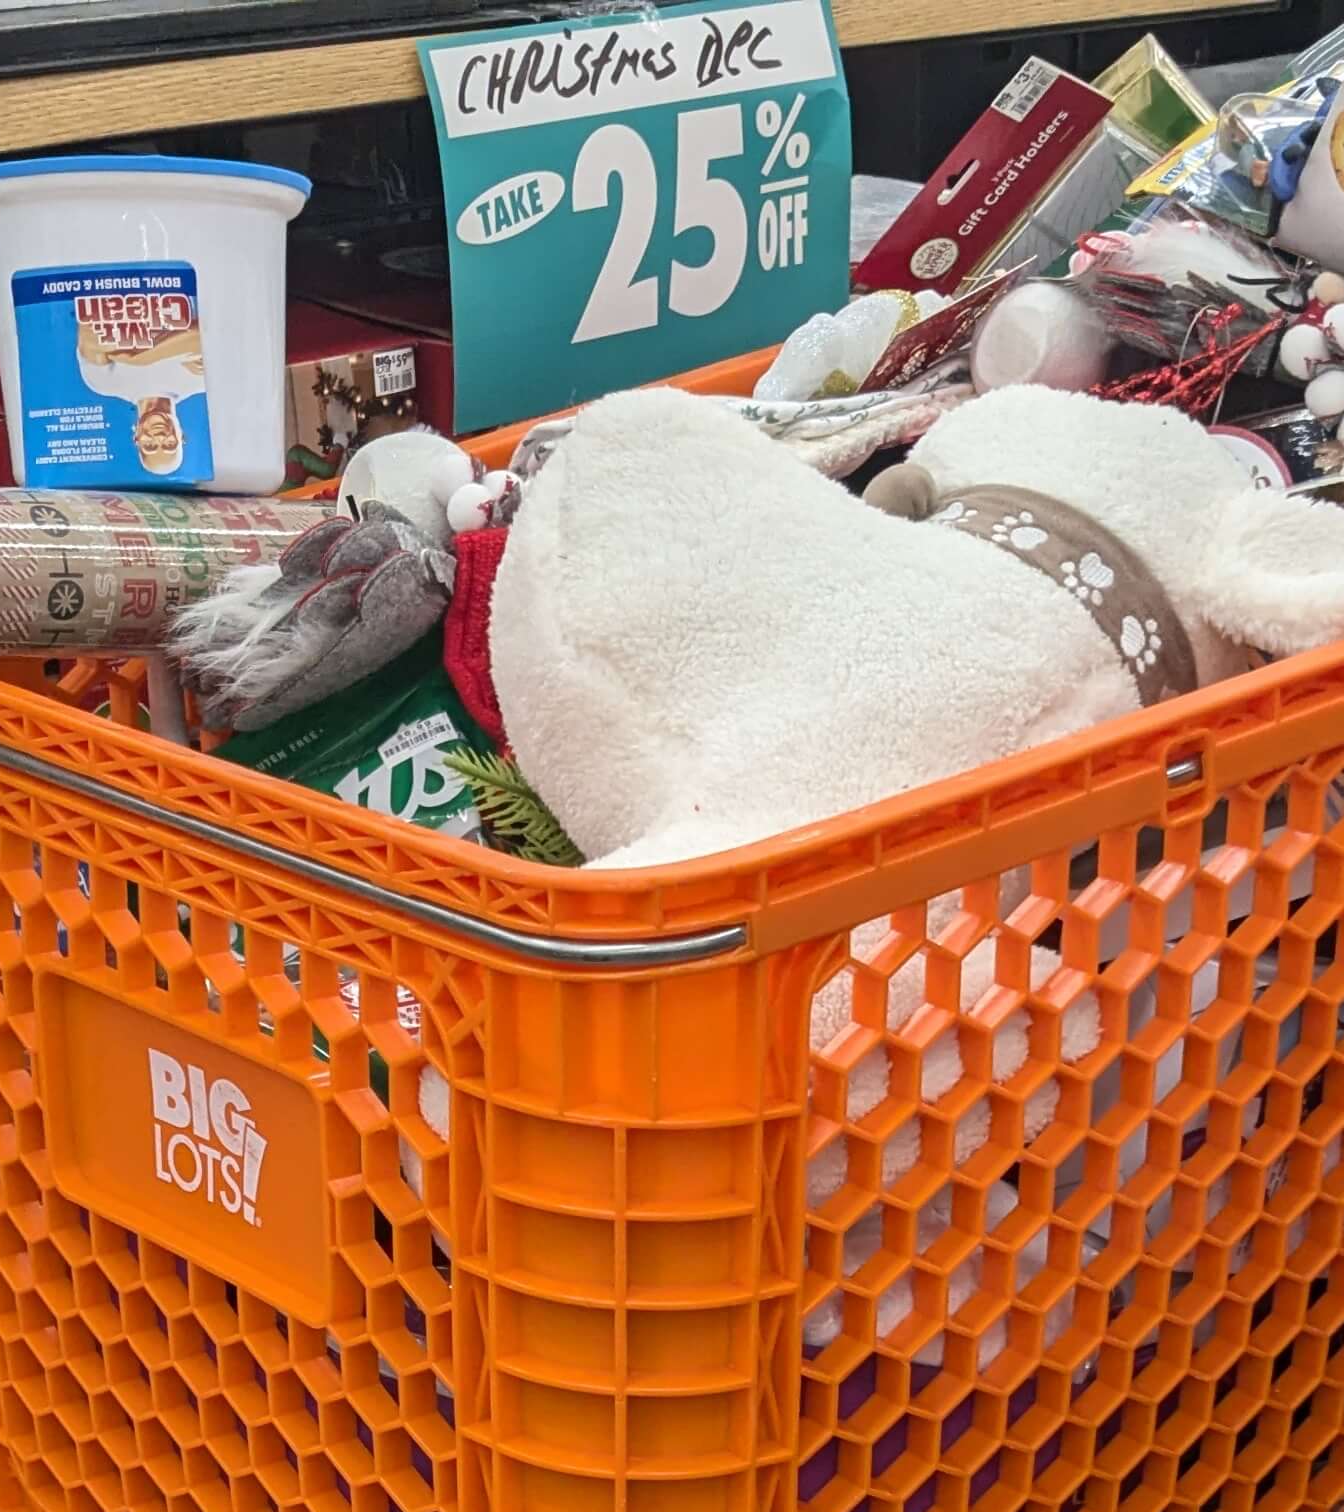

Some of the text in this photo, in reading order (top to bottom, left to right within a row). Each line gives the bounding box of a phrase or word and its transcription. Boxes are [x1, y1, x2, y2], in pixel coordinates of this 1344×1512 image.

[958, 110, 1069, 236] Gift Card Holders
[476, 179, 544, 238] TAKE
[758, 192, 808, 271] OFF
[42, 276, 181, 294] BOWL BRUSH & CADDY
[75, 293, 192, 331] Clean
[92, 321, 154, 349] Mr.
[148, 1047, 256, 1157] BIG
[154, 1122, 269, 1227] LOTS!
